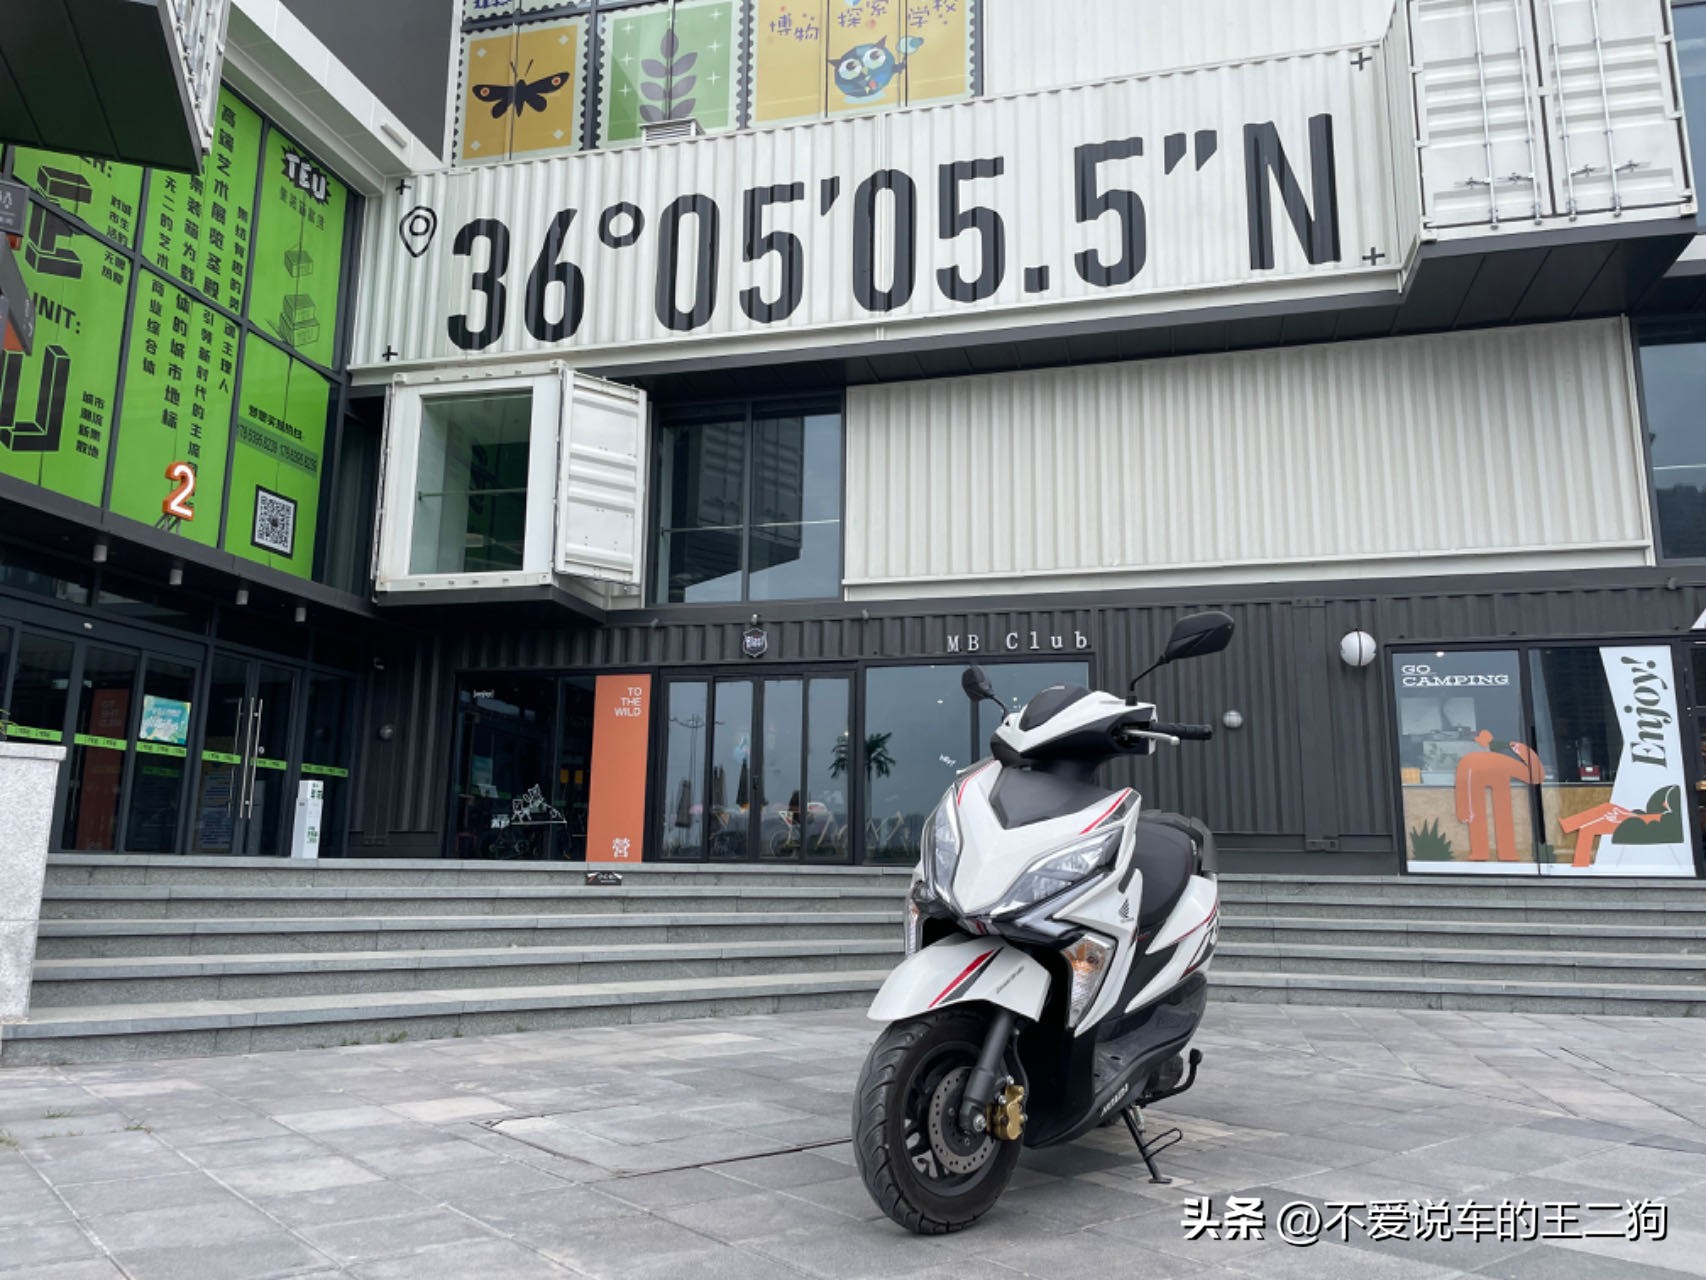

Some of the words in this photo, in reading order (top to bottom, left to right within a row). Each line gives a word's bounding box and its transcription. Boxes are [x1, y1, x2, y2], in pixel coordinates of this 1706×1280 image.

[285, 151, 327, 201] TEU
[162, 461, 197, 521] 2
[947, 634, 980, 652] MB
[1005, 630, 1088, 650] Club
[1401, 664, 1431, 675] GO
[1402, 674, 1510, 687] CAMPING
[627, 686, 642, 697] TO
[620, 696, 642, 707] THE
[614, 706, 642, 717] WILD
[1620, 655, 1672, 768] Enjoy!
